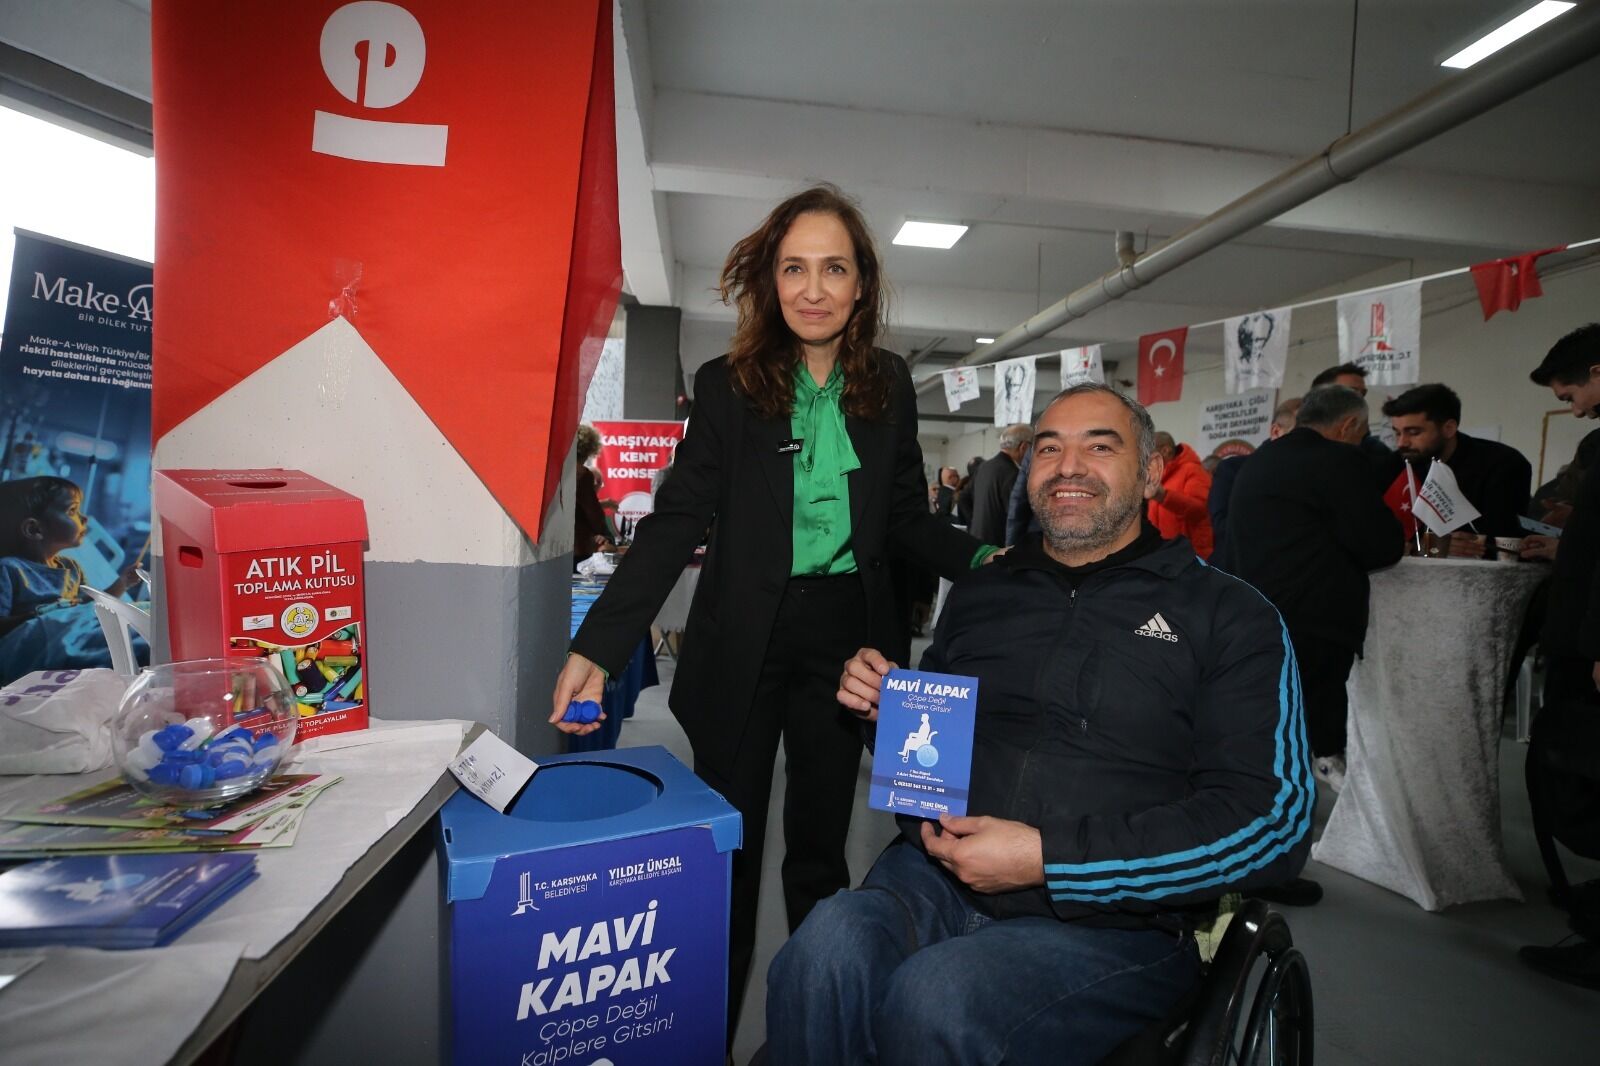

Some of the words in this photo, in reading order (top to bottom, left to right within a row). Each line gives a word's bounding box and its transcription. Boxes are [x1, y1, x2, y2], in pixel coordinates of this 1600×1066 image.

[78, 313, 95, 322] BİR
[98, 317, 127, 329] DİLEK
[130, 323, 148, 332] TUT
[29, 335, 99, 353] Make-A-Wish
[19, 344, 49, 356] riskli
[49, 349, 117, 365] hastalıklarla
[23, 366, 62, 378] hayata
[64, 371, 90, 381] daha
[91, 375, 111, 384] sıkı
[51, 360, 98, 373] dileklerini
[620, 452, 658, 463] KENT
[246, 556, 302, 579] ATIK
[311, 550, 345, 574] PİL
[234, 577, 302, 596] TOPLAMA
[305, 575, 356, 590] KUTUSU
[1134, 629, 1179, 643] adidas
[887, 678, 921, 693] MAVİ
[924, 682, 971, 699] KAPAK
[907, 693, 927, 704] Çöpe
[927, 695, 947, 705] Değil
[255, 725, 271, 735] ATIK
[305, 713, 347, 728] TOPLAYALIM
[608, 863, 645, 880] YILDIZ
[647, 855, 682, 872] ÜNSAL
[534, 881, 550, 891] T.C.
[551, 873, 598, 888] KARŞIYAKA
[608, 876, 637, 887] KARŞIYAKA
[637, 871, 660, 881] BELEDİYE
[544, 883, 588, 899] BELEDİYESİ
[536, 899, 659, 971] MAVİ
[516, 947, 677, 1021] KAPAK
[539, 1013, 599, 1045] Çöpe
[605, 993, 659, 1024] Değil
[521, 1034, 607, 1066] Kalplere
[613, 1012, 674, 1044] Gitsin!
